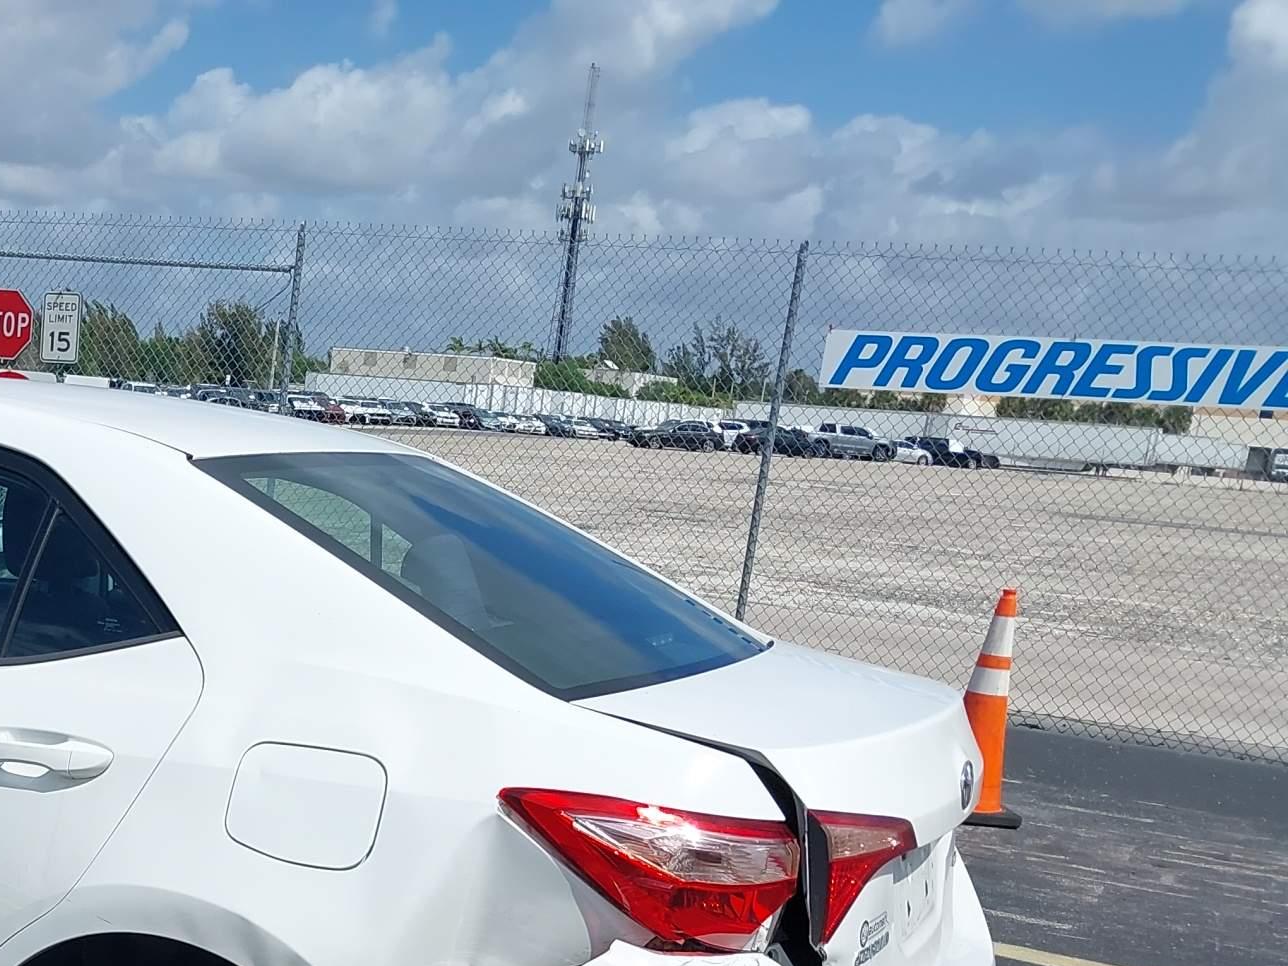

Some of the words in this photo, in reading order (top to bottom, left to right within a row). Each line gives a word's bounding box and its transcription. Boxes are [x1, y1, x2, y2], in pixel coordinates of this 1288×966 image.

[46, 302, 77, 312] SPEED
[49, 314, 73, 323] LIMIT
[49, 331, 71, 353] 15
